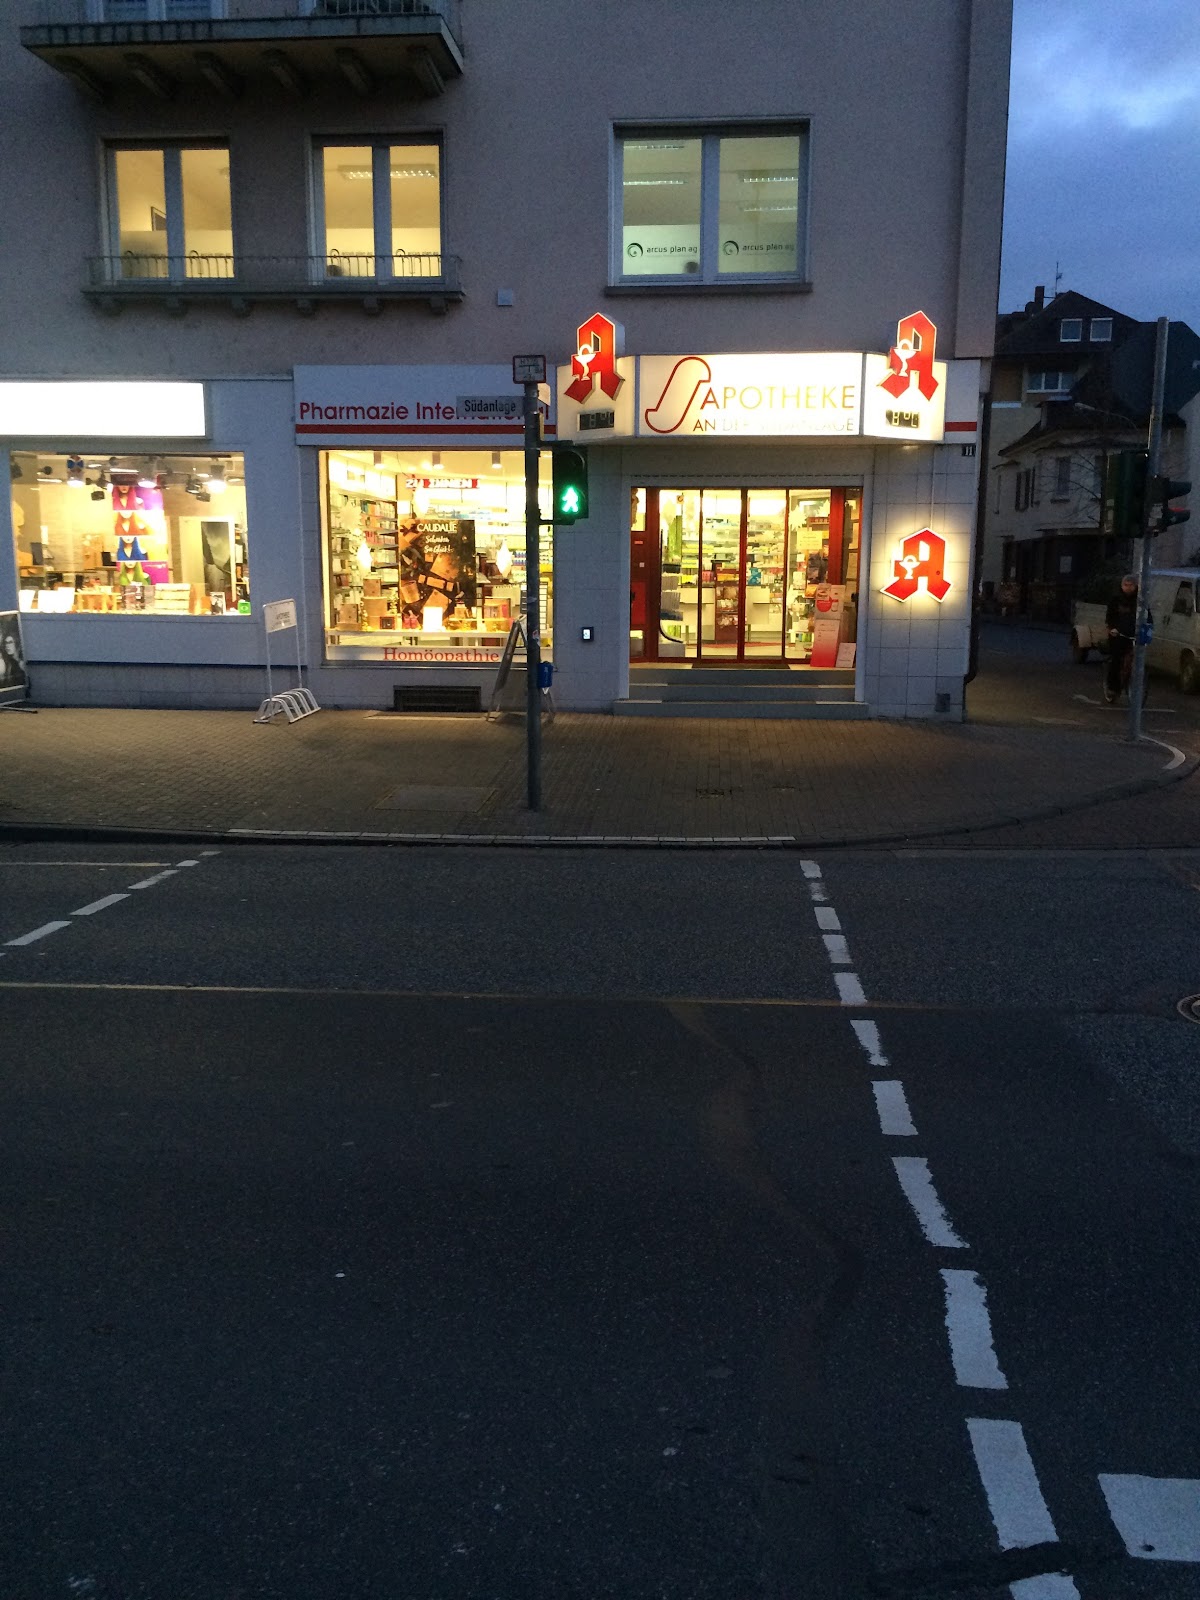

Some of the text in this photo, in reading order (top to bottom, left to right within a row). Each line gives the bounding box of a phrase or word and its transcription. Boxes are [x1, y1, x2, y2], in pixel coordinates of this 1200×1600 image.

[670, 244, 686, 254] plan
[688, 246, 698, 254] ag
[742, 244, 764, 252] arcus
[766, 243, 782, 252] plan
[700, 385, 855, 410] APOTHEKE
[300, 402, 409, 420] Pharmazie
[464, 399, 516, 415] Südanlage
[692, 418, 717, 432] AN
[965, 446, 973, 456] 11
[382, 647, 500, 662] Homöopathie
